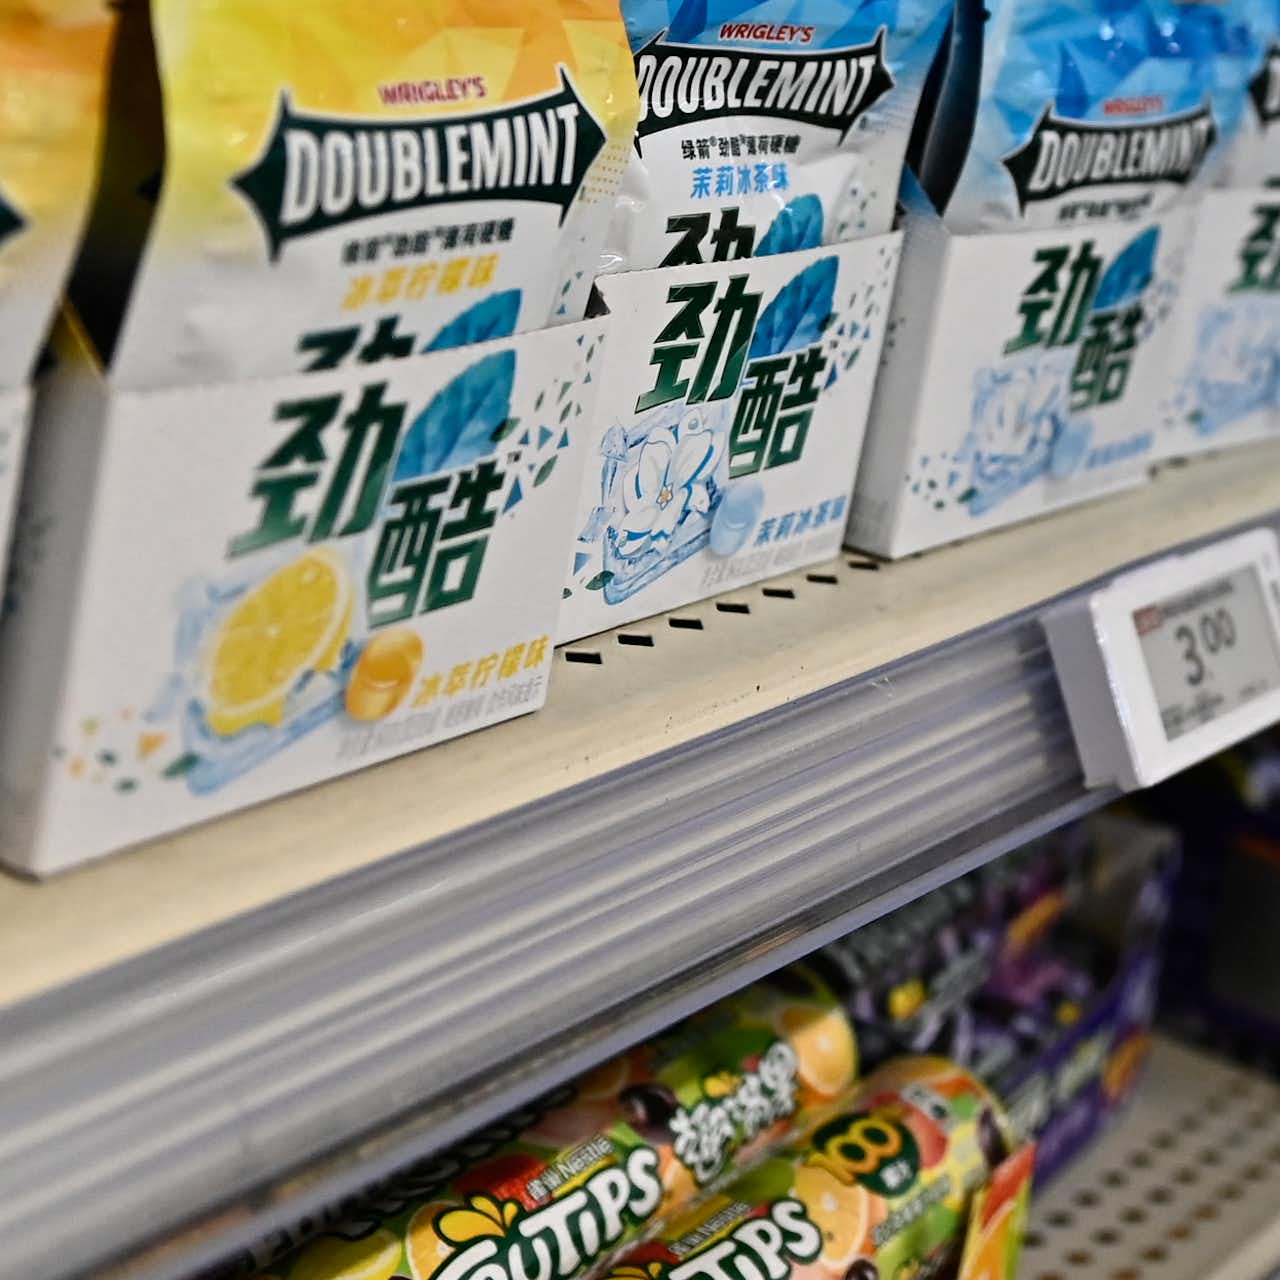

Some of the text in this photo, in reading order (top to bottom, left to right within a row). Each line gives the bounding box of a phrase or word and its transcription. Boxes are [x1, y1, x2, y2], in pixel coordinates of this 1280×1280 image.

[377, 76, 488, 106] WRIGLEY'S
[718, 22, 816, 44] WRIGLEY'S
[280, 102, 581, 223] DOUBLEMINT
[634, 273, 827, 480] 劲酷
[1003, 239, 1144, 414] 劲酷
[225, 378, 507, 631] 劲酷
